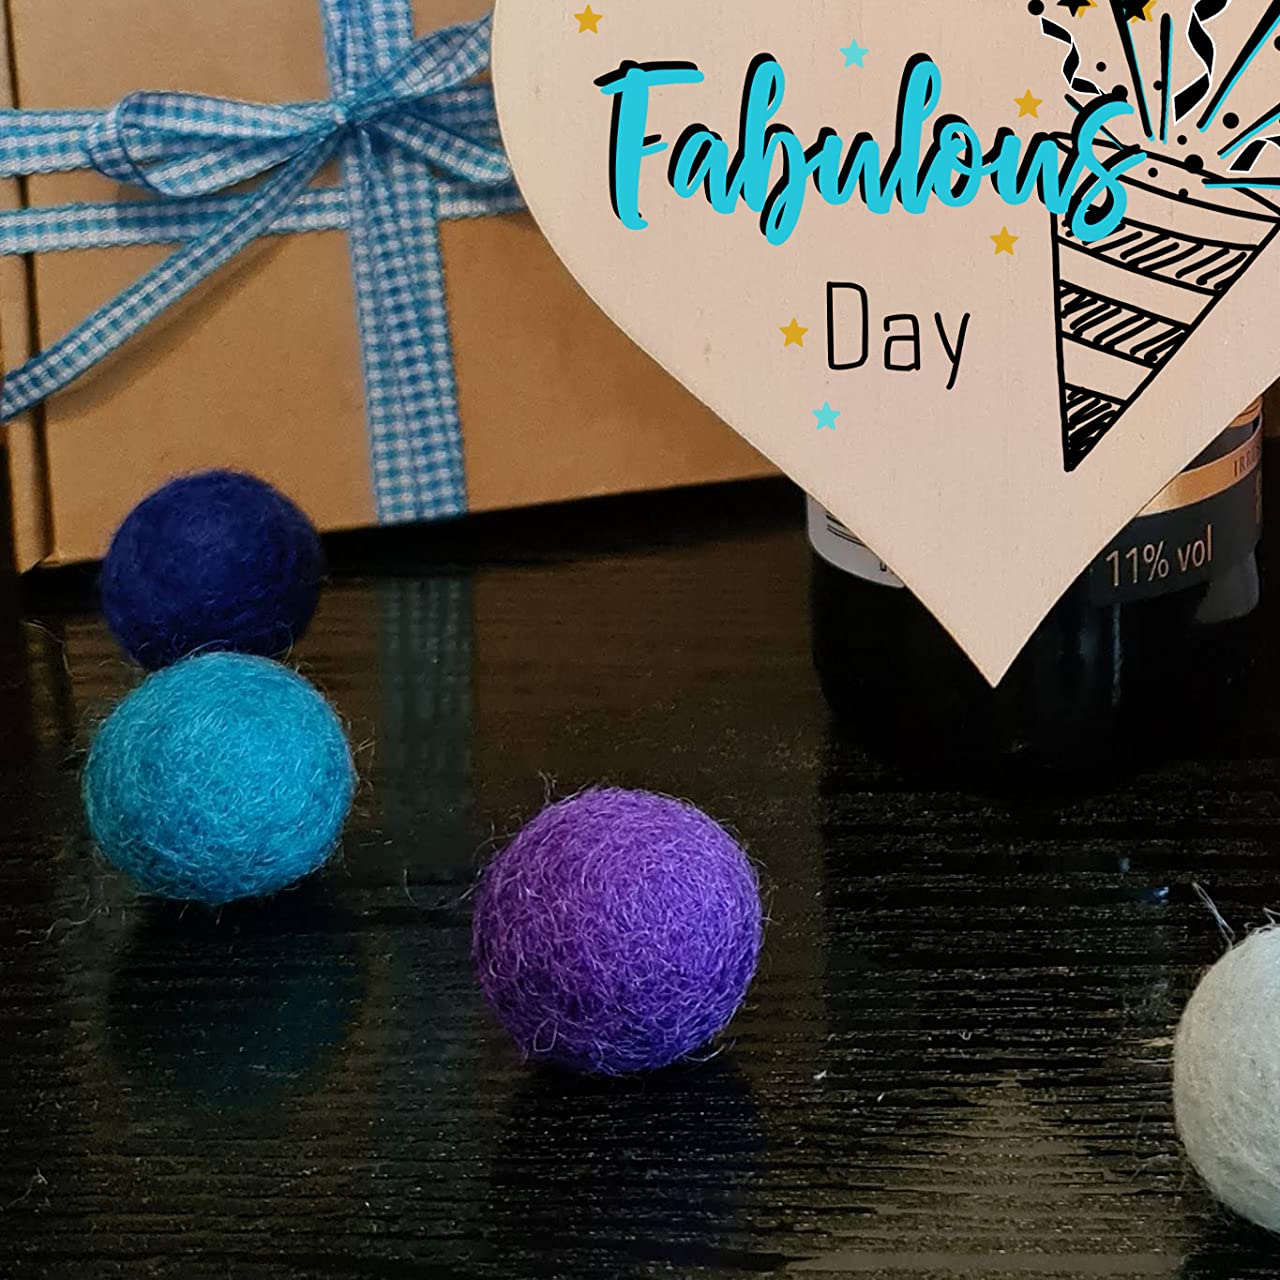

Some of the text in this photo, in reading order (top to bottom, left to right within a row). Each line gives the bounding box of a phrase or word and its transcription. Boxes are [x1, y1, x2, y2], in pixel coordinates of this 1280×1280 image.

[593, 52, 1147, 247] Fabulous
[825, 280, 972, 390] Day
[1105, 524, 1213, 588] 11% vol
